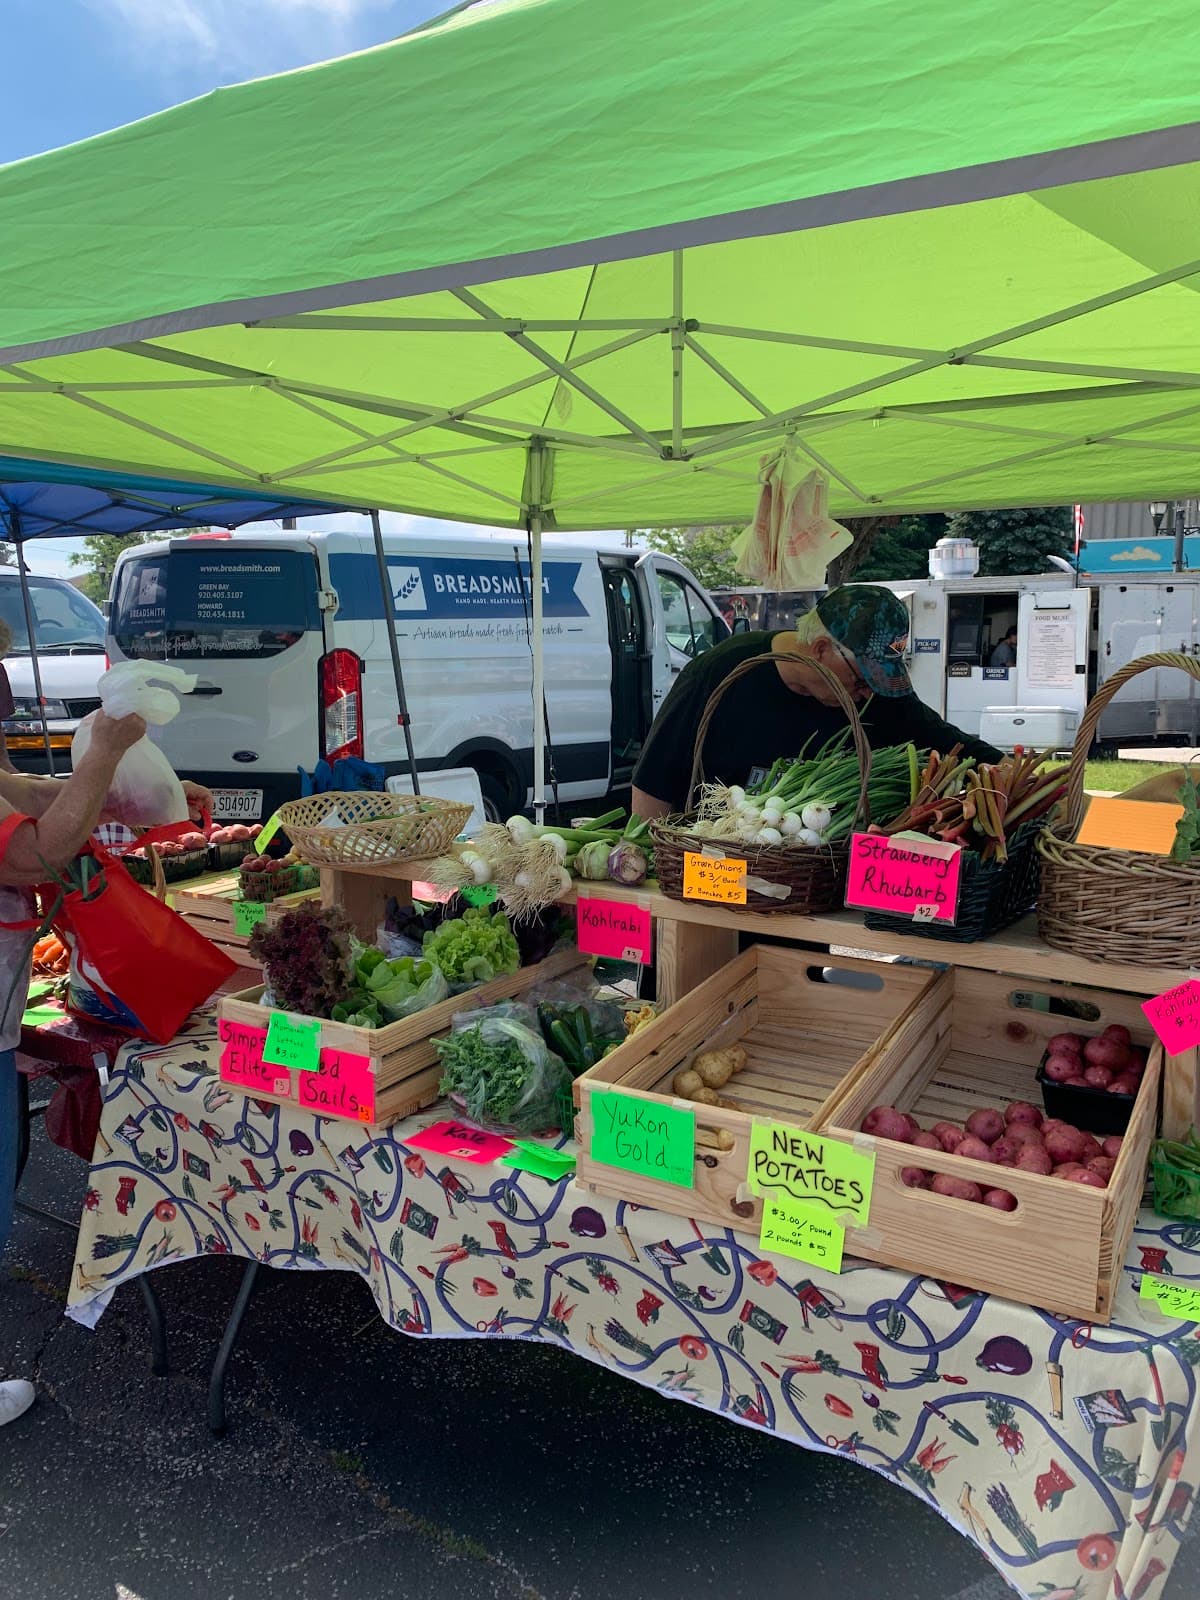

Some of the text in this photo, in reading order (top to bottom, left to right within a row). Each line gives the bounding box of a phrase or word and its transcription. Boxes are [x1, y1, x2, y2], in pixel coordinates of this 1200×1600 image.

[200, 564, 281, 573] www.breadsmith.com
[413, 626, 447, 640] Artisan
[449, 624, 473, 639] breads
[475, 625, 494, 638] made
[496, 624, 515, 641] fresh
[542, 623, 564, 636] ratch
[218, 796, 257, 811] SD4907
[713, 860, 743, 873] Onions
[857, 837, 952, 878] Strawberry
[686, 886, 694, 894] 2
[861, 866, 948, 903] Rhubarb
[582, 906, 642, 933] Kohlrabi
[918, 906, 933, 918] $2
[230, 1051, 272, 1081] Elite
[304, 1078, 359, 1111] Sails
[443, 1125, 487, 1144] Kale
[772, 1130, 824, 1165] NEW
[615, 1130, 669, 1169] Gold
[754, 1150, 864, 1204] POTATOES
[764, 1229, 775, 1239] 2
[808, 1242, 828, 1257] $5
